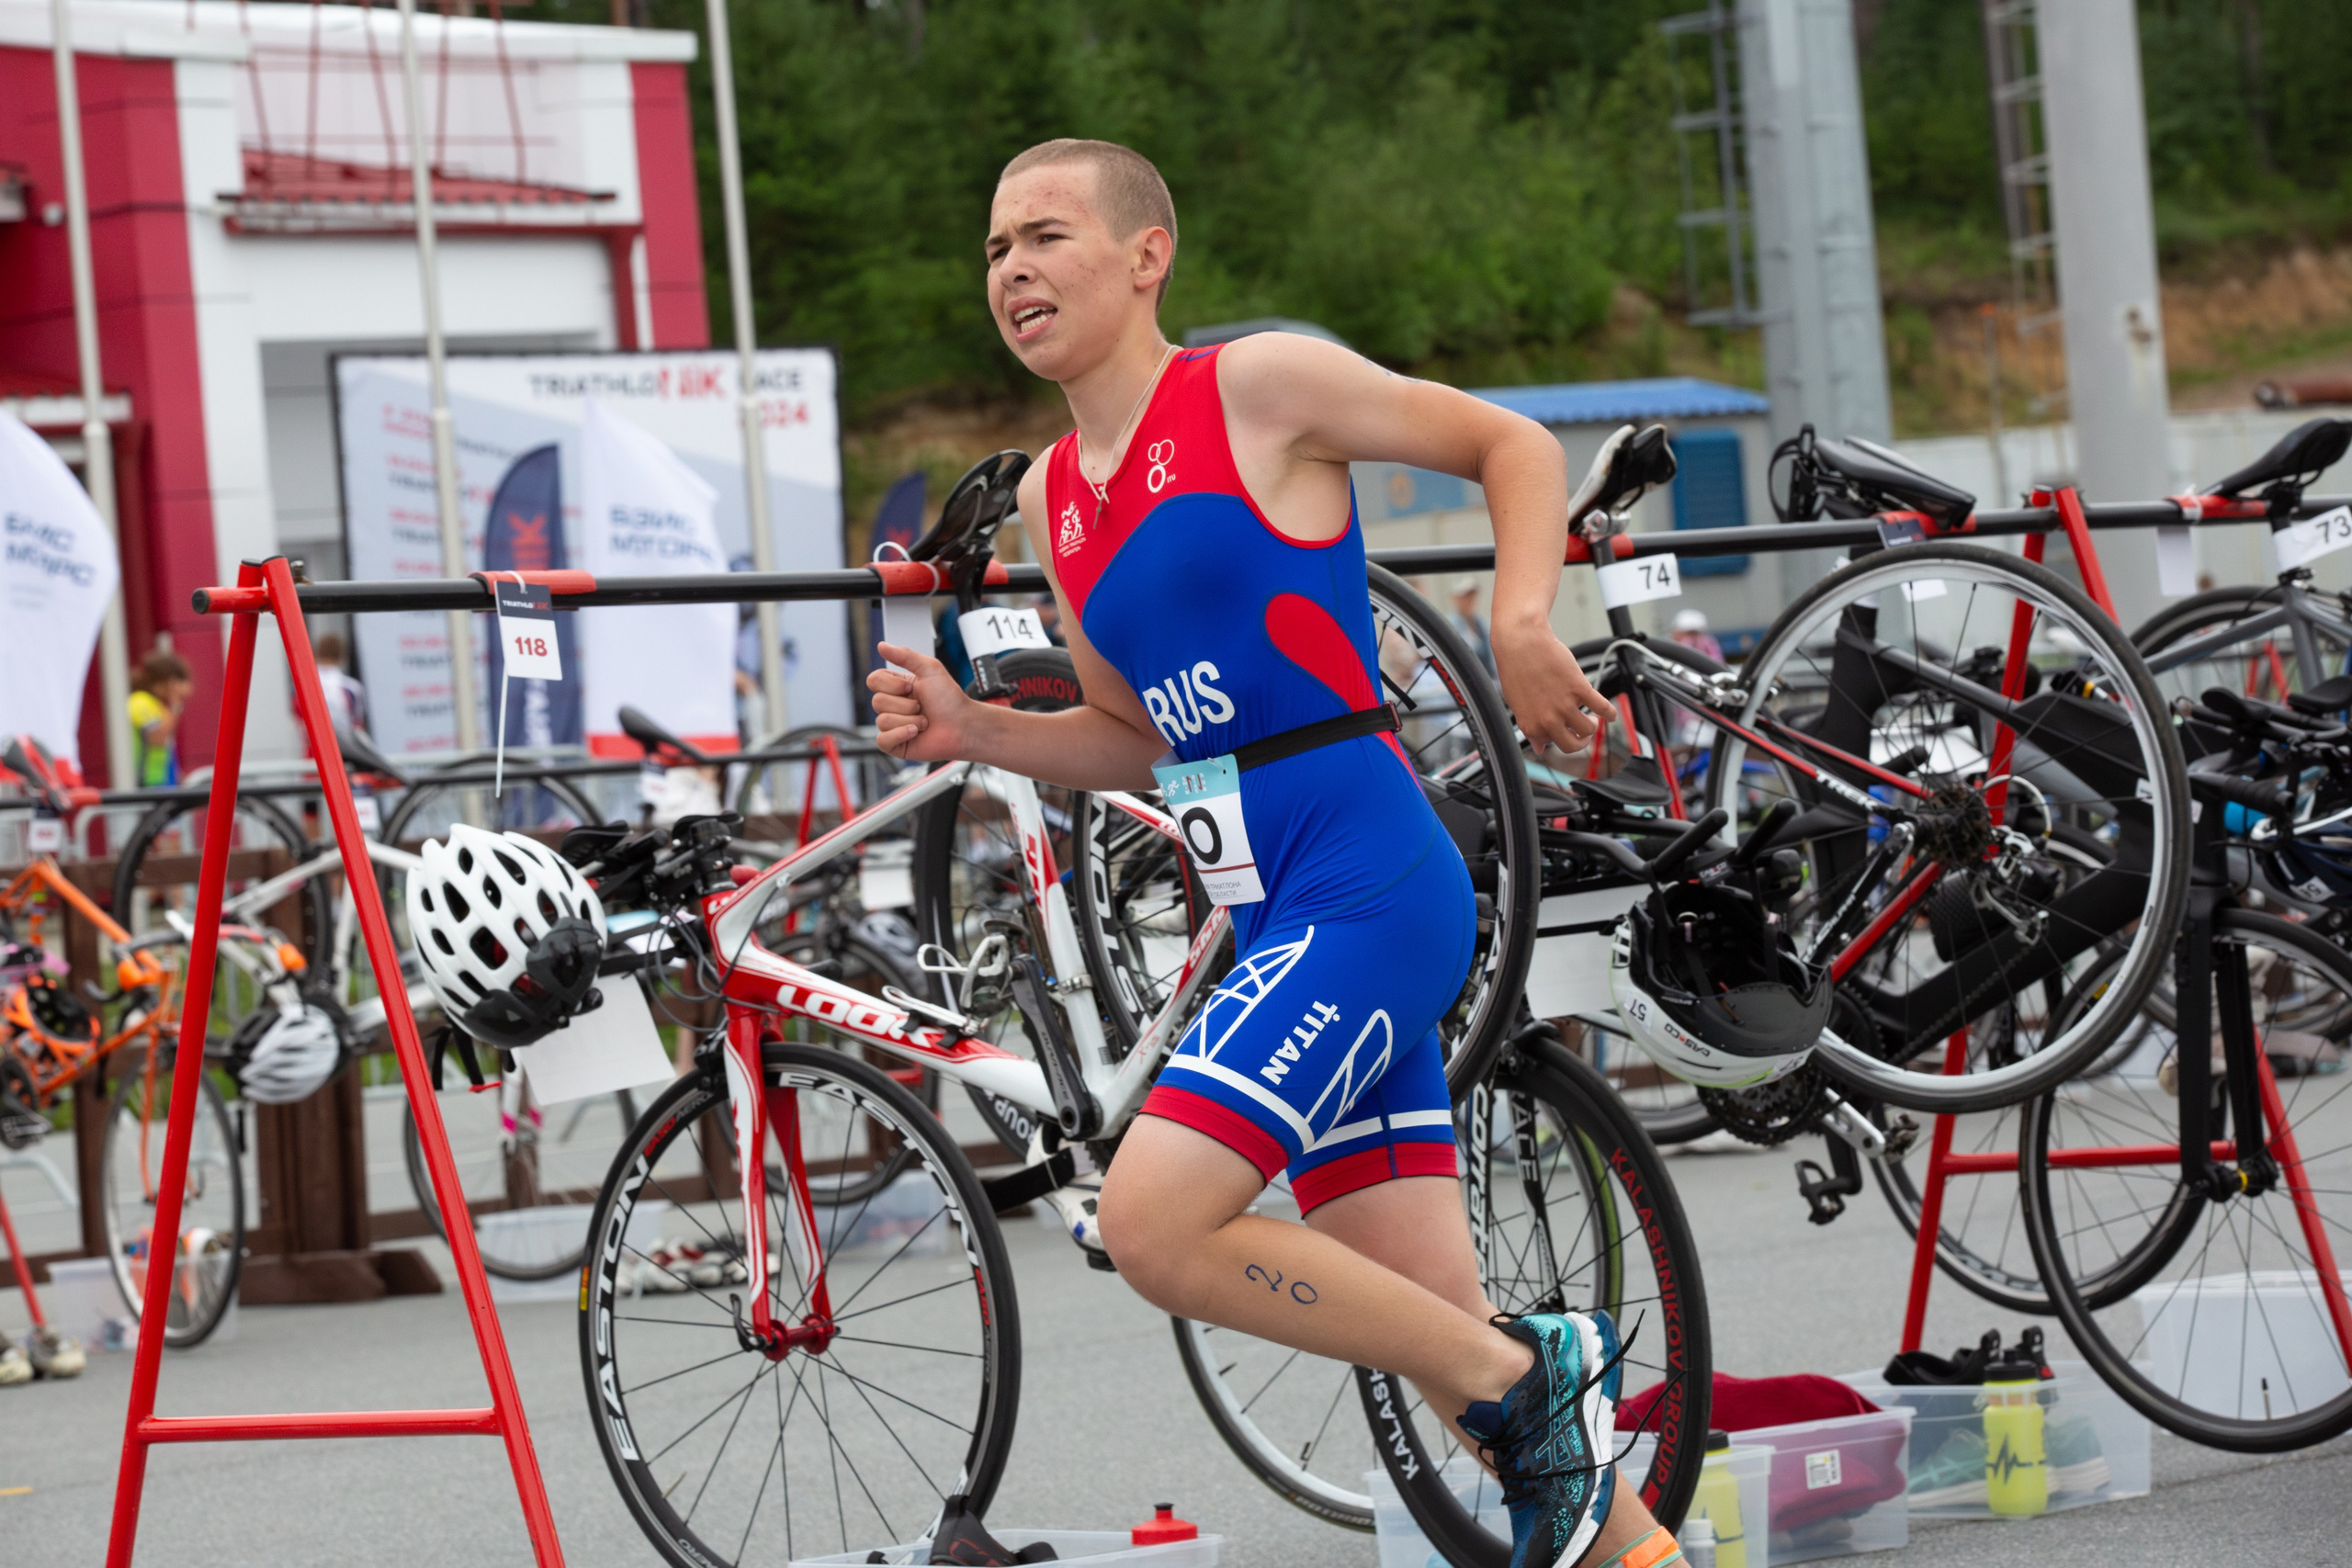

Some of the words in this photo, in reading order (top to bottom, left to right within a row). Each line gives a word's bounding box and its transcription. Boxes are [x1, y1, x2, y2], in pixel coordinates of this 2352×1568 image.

[1167, 473, 1176, 483] ITU
[2315, 515, 2351, 544] 73
[1638, 563, 1671, 591] 74
[987, 614, 1035, 640] 114
[515, 636, 548, 658] 118
[1142, 660, 1236, 747] RUS
[776, 983, 946, 1049] LOOK
[1629, 998, 1647, 1021] 57
[778, 1071, 979, 1267] EASTON
[1245, 1263, 1318, 1305] 20
[594, 1155, 650, 1462] EASTON
[1611, 1147, 1683, 1371] KALASHNIKOV
[1656, 1381, 1683, 1484] GROUP
